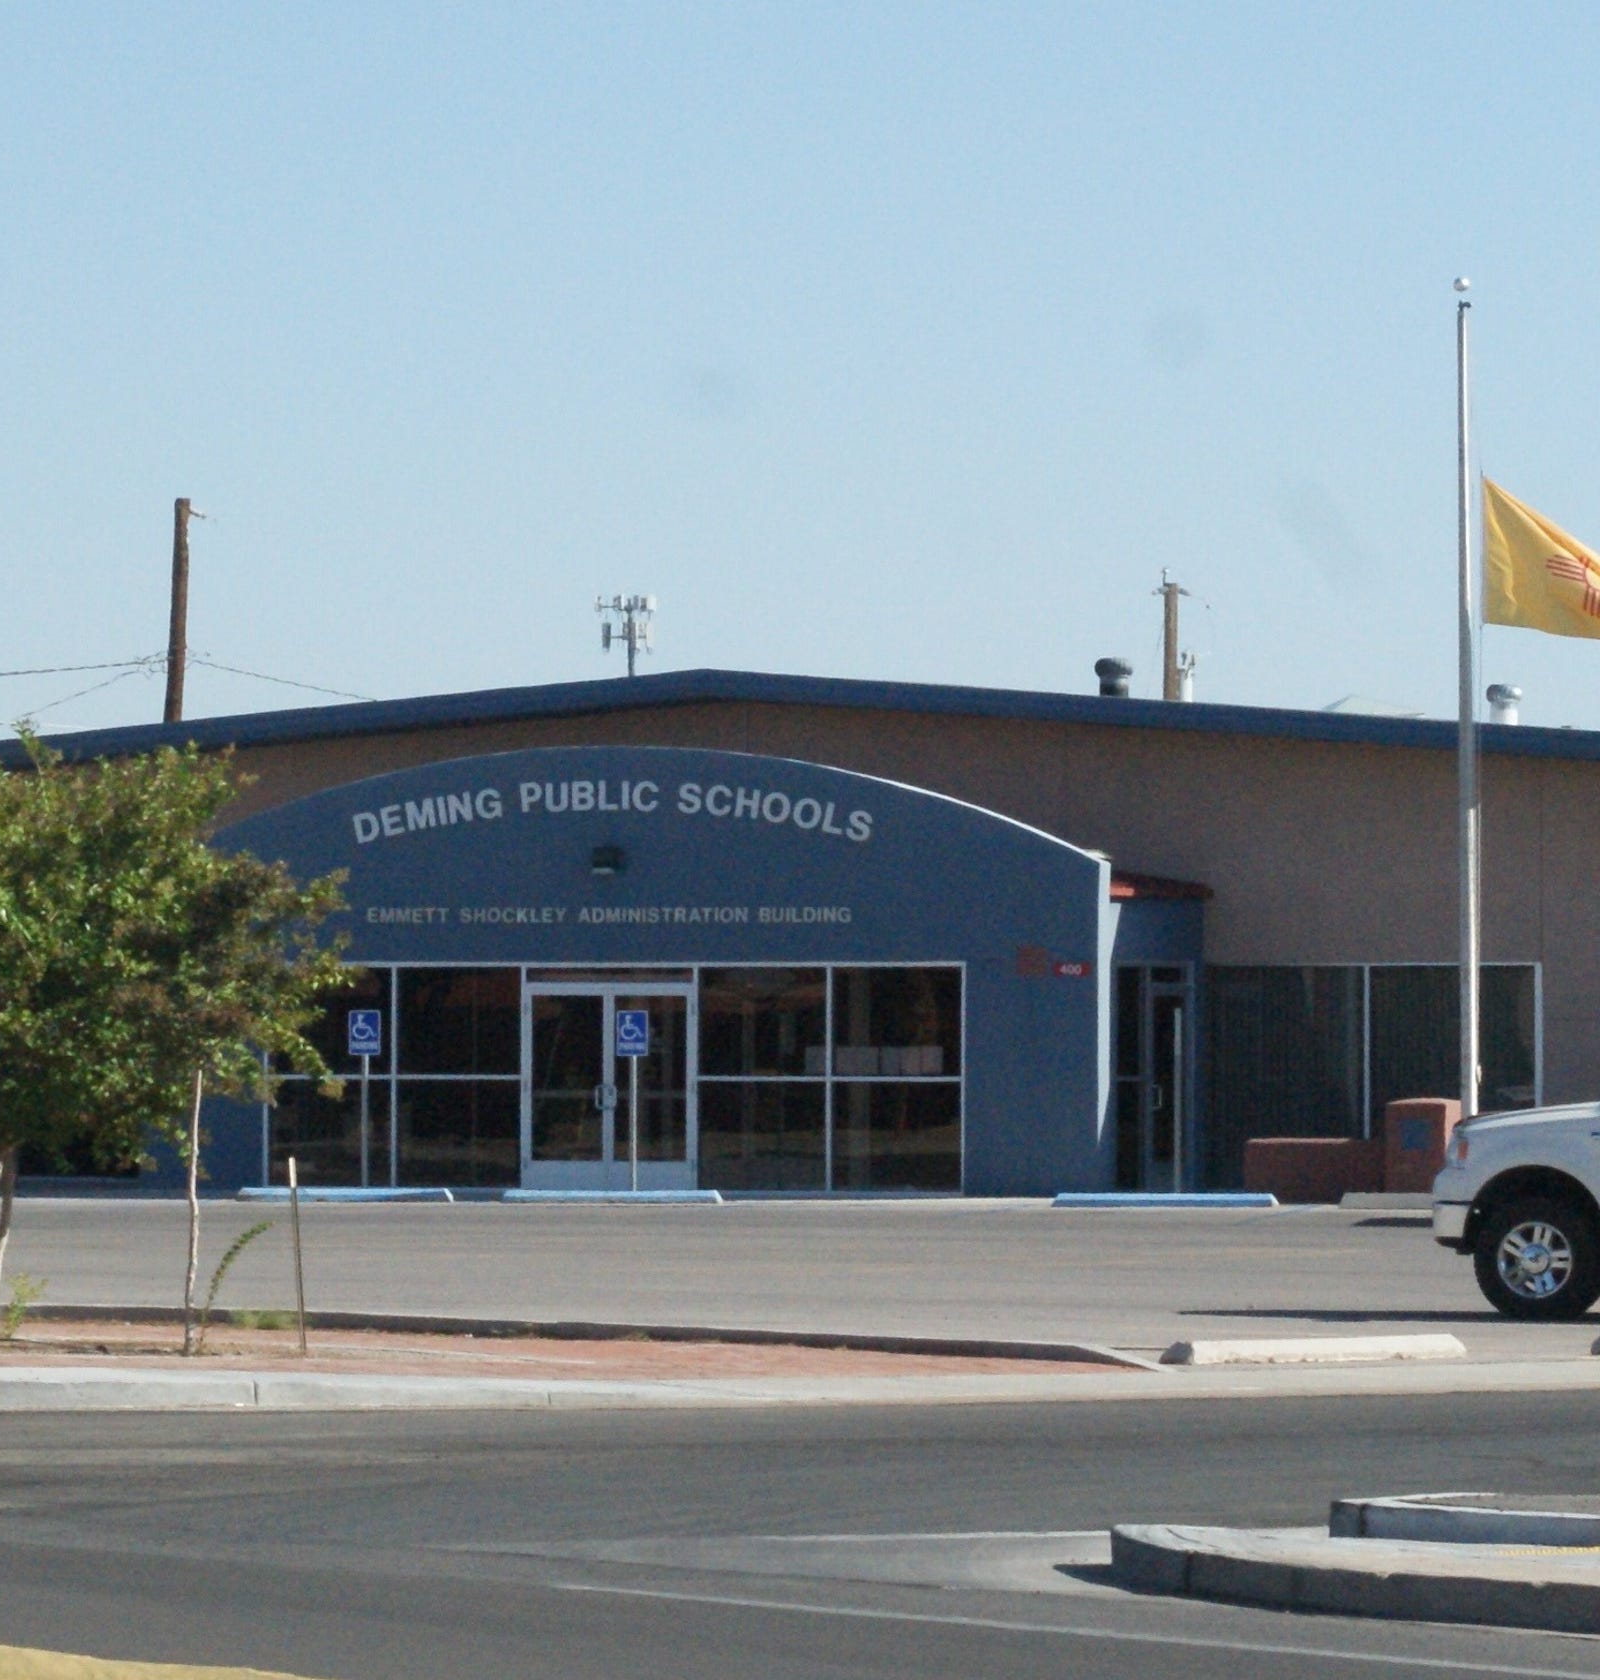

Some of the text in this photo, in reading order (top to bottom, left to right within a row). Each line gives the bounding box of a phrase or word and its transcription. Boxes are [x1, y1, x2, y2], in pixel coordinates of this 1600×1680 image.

[352, 780, 873, 844] DEMING PUBLIC SCHOOLS
[367, 906, 852, 924] EMMETT SHOCKLEY ADMINISTRATION BUILDING
[1060, 963, 1082, 976] 400
